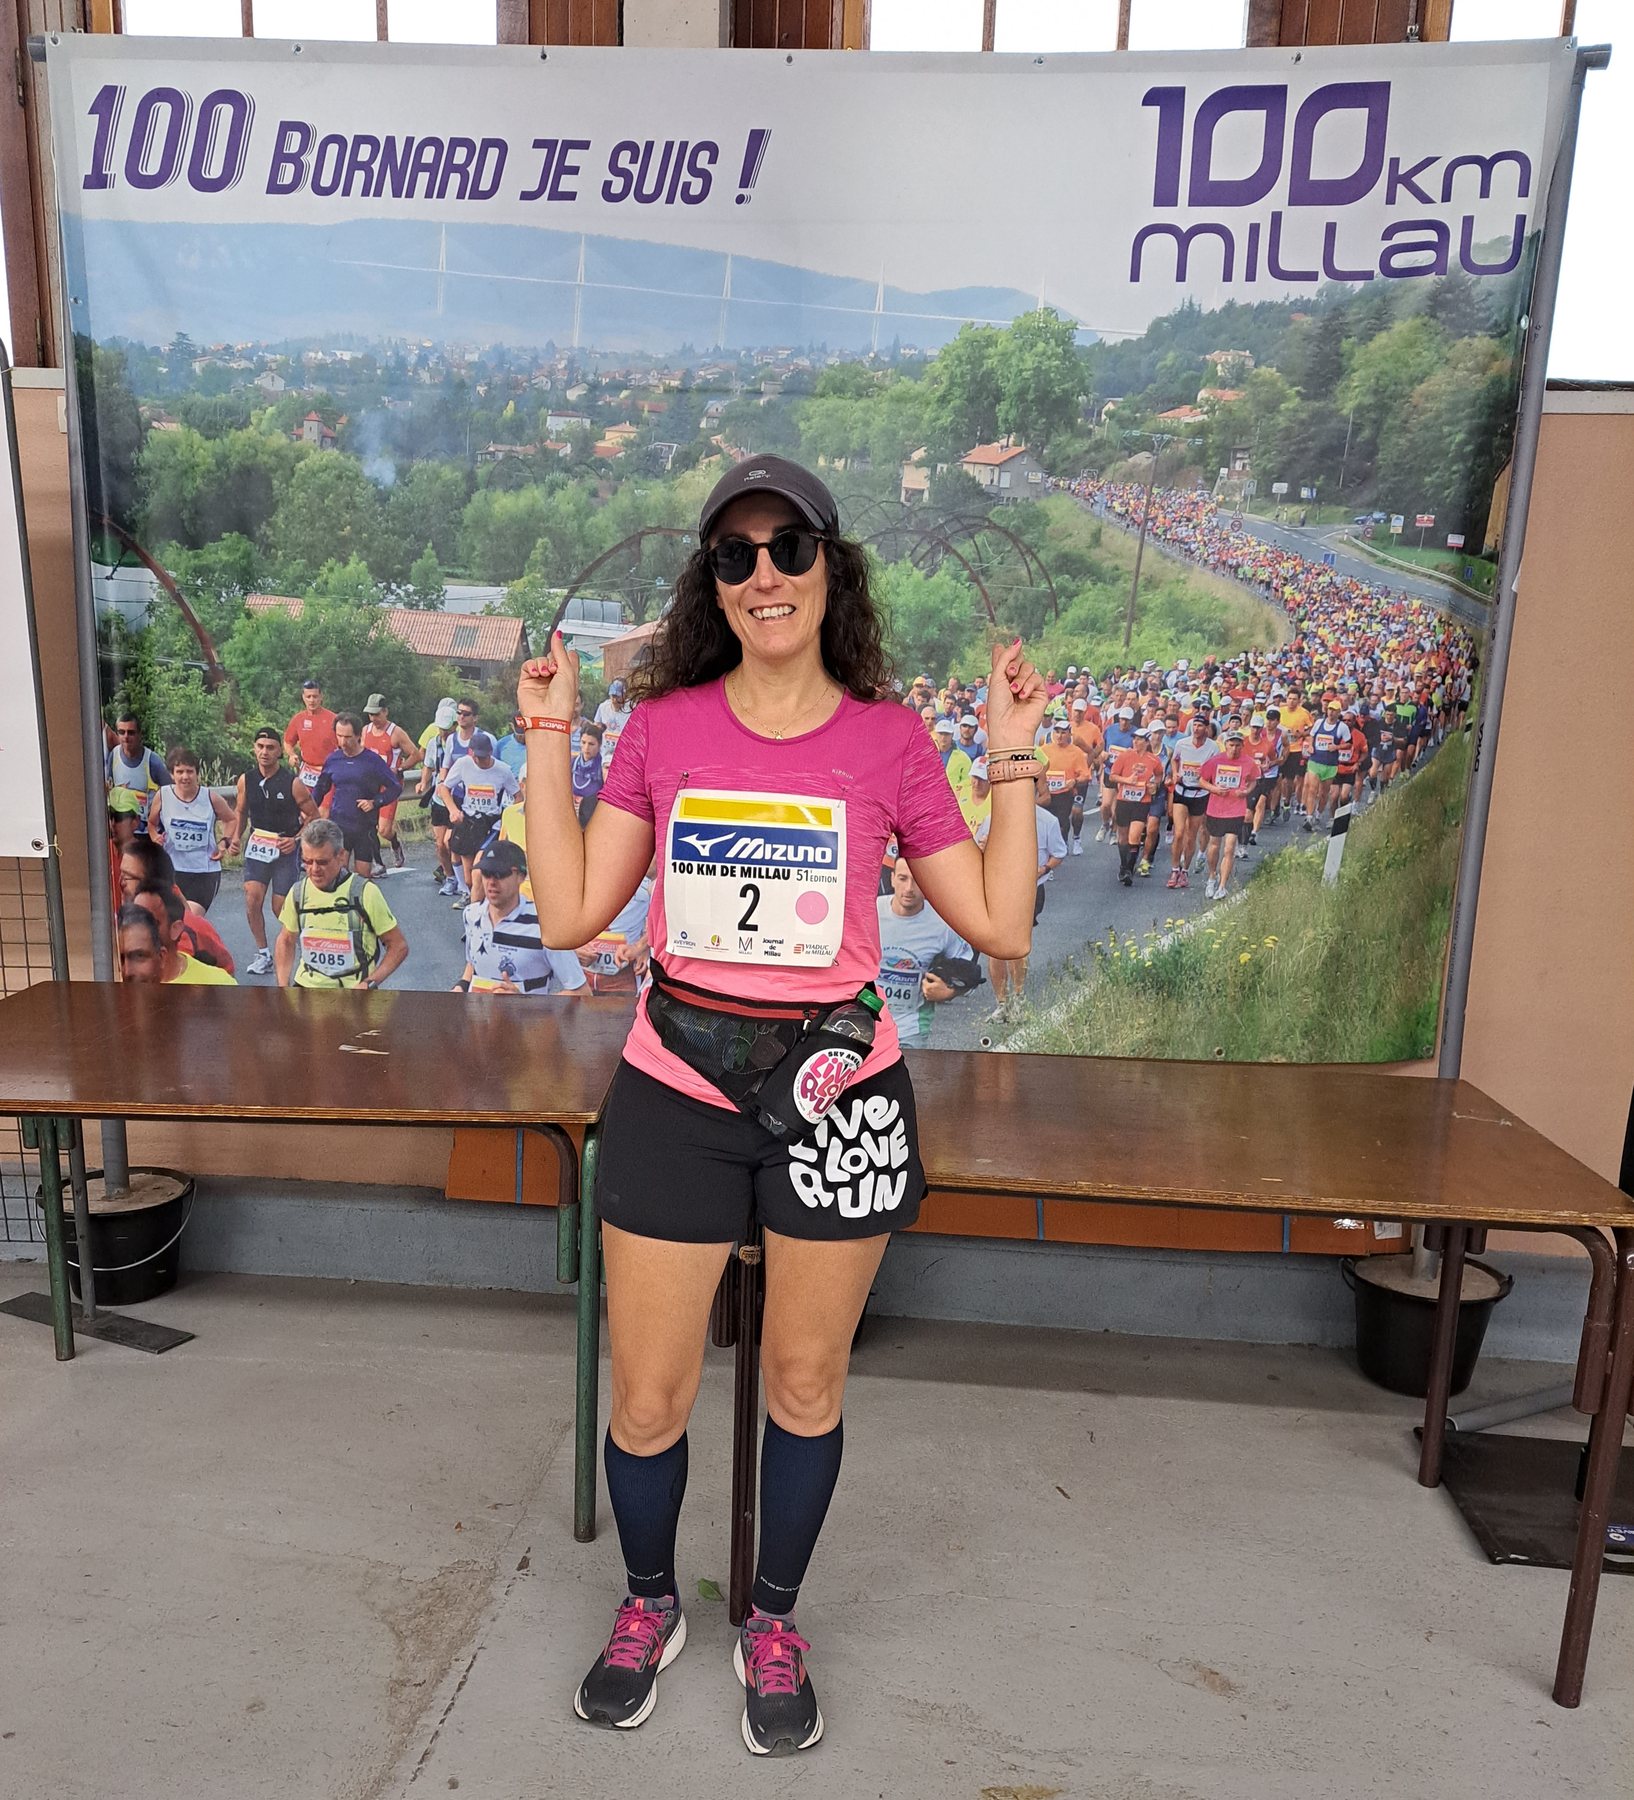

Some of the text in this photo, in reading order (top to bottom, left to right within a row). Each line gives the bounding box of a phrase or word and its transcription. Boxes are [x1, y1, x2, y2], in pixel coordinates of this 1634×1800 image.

[83, 84, 256, 193] 100
[518, 139, 591, 201] JE
[601, 140, 719, 205] SUIS
[175, 831, 203, 841] 5243
[251, 843, 274, 856] 841
[671, 861, 694, 875] 100
[696, 863, 717, 877] KM
[720, 865, 737, 878] DE
[740, 866, 791, 881] MILLAU
[737, 883, 761, 932] 2
[310, 951, 345, 966] 2085
[879, 985, 911, 1000] 046
[825, 1117, 909, 1182] LOVE
[788, 1161, 908, 1218] RUN
